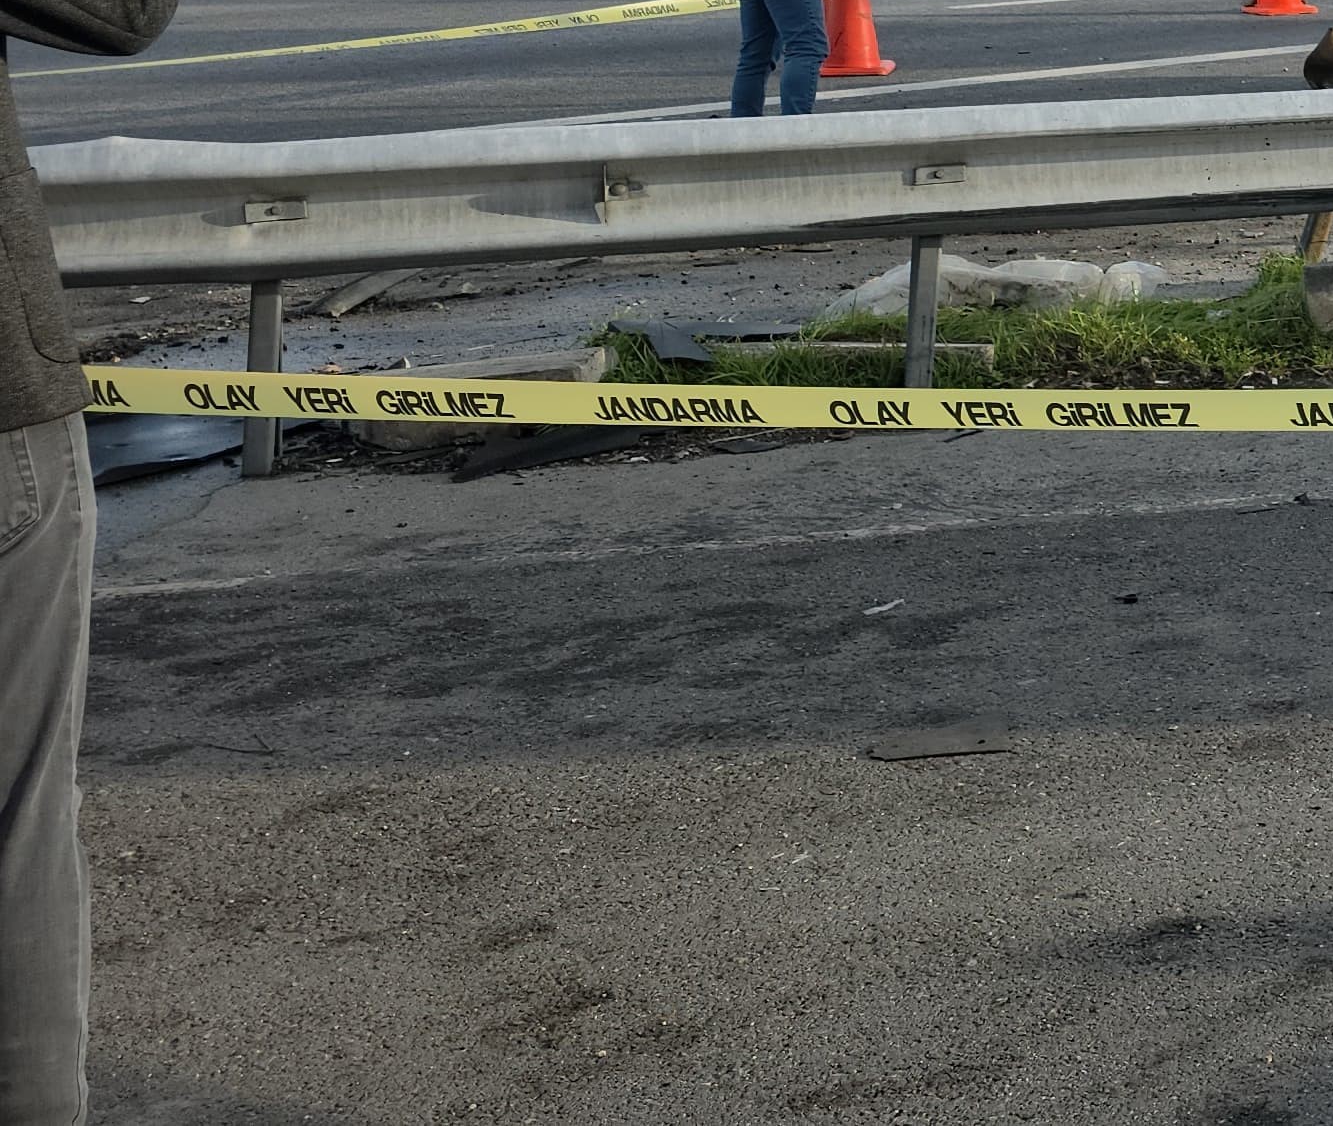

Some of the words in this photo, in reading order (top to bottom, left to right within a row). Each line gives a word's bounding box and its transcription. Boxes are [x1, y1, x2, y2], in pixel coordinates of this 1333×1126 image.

[183, 383, 260, 411] OLAY
[594, 396, 767, 425] JANDARMA
[829, 400, 914, 427] OLAY
